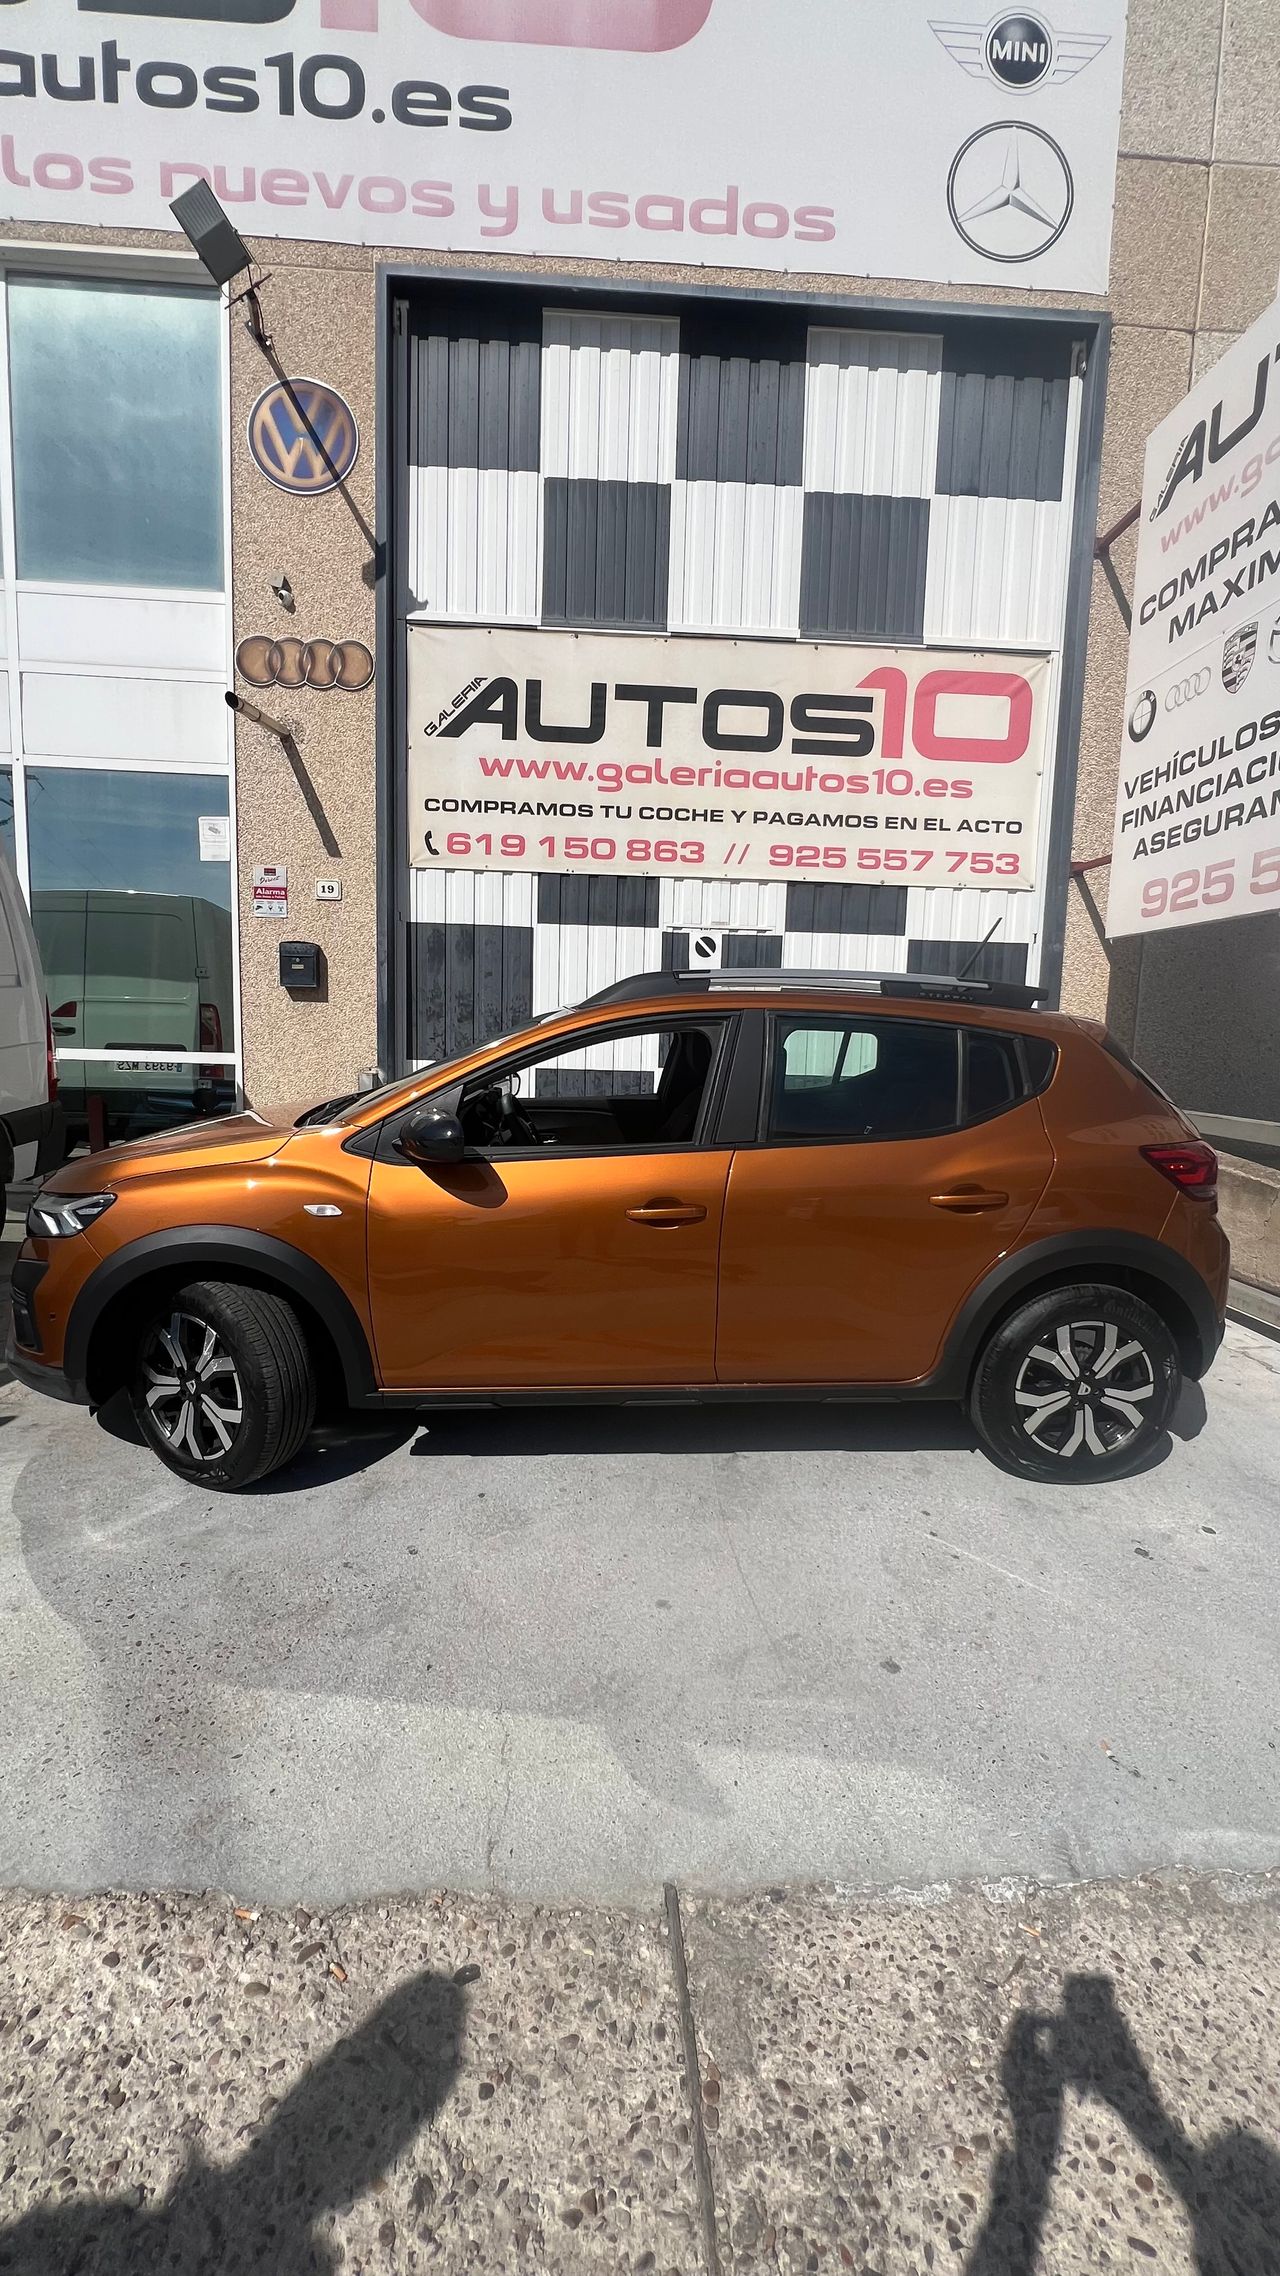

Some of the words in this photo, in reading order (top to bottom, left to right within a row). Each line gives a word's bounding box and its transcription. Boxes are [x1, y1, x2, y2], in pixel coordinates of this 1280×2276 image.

[991, 39, 1046, 64] MINI
[1, 135, 134, 195] los
[160, 161, 456, 218] nuevos
[477, 184, 519, 237] y
[541, 186, 836, 242] usados
[1156, 343, 1280, 518] AU
[1139, 500, 1280, 626] COMPRA
[1168, 550, 1280, 643] MAXIM
[423, 677, 489, 737] GALERIA
[435, 666, 1033, 764] AUTOS10
[478, 757, 973, 799] www.galeriaautos10.es
[1123, 710, 1280, 800] VEHÍCULOS
[424, 798, 594, 818] COMPRAMOS
[600, 805, 632, 819] TU
[638, 807, 724, 822] COCHE
[731, 810, 747, 823] Y
[752, 811, 878, 829] PAGAMOS
[884, 817, 917, 831] EN
[923, 818, 951, 831] EL
[956, 819, 1023, 835] ACTO
[1120, 748, 1280, 834] FINANCIACI
[446, 832, 526, 857] 619
[538, 836, 617, 860] 150
[626, 839, 705, 864] 863
[768, 844, 847, 869] 925
[856, 848, 934, 872] 557
[944, 851, 1020, 875] 753
[255, 887, 286, 896] Alarma
[320, 884, 335, 894] 19
[1140, 858, 1236, 919] 925
